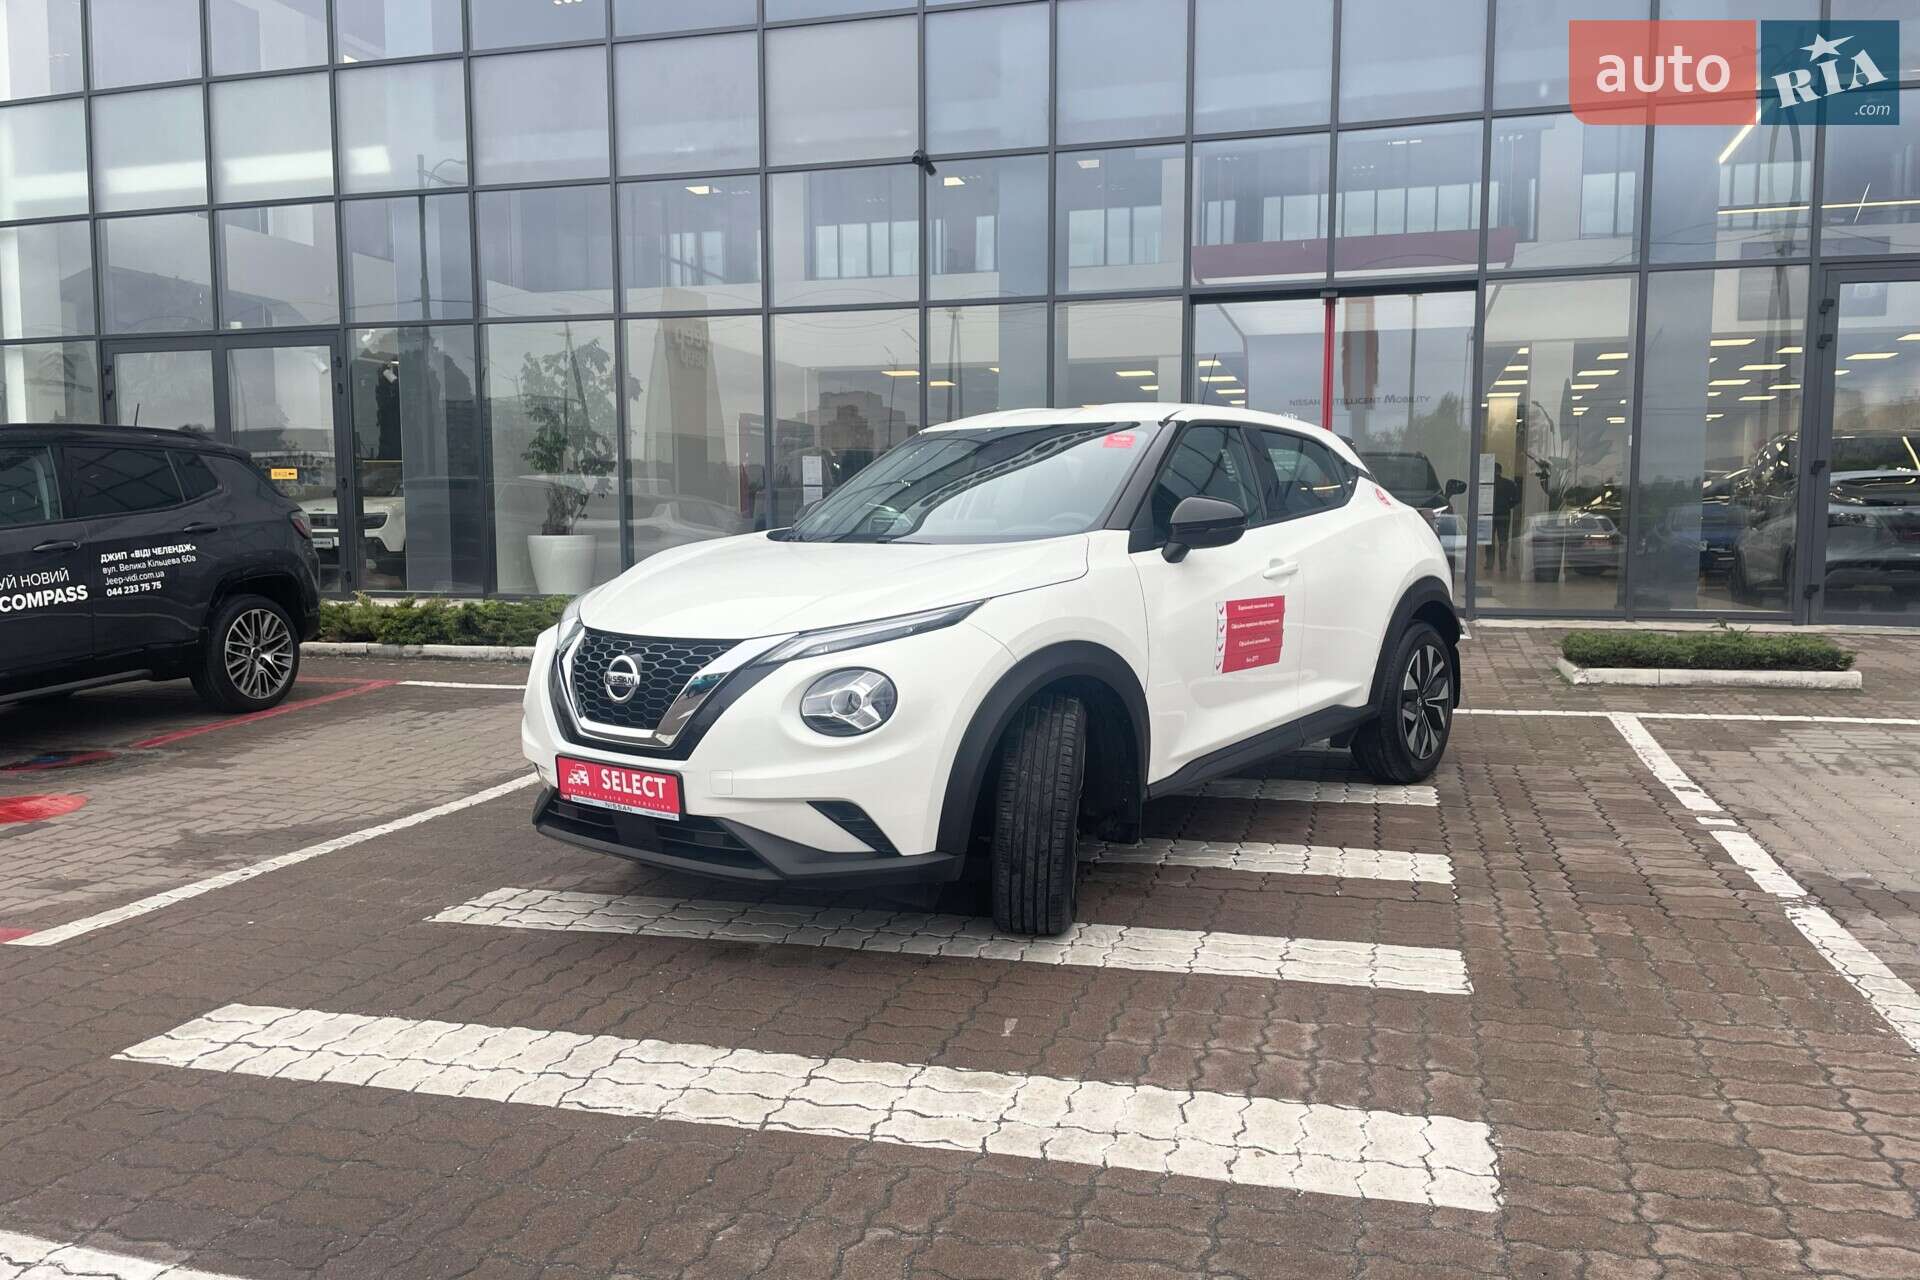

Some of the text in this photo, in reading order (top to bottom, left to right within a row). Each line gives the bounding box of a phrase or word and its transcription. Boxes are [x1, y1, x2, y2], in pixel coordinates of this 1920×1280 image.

[100, 551, 128, 564] ДЖИП
[102, 566, 118, 575] вул.
[119, 562, 147, 572] Велика
[147, 557, 181, 567] Кільцева
[20, 567, 70, 588] НОВИЙ
[0, 584, 89, 613] COMPASS
[106, 581, 162, 597] 044 233 75 75
[601, 768, 666, 800] SELECT
